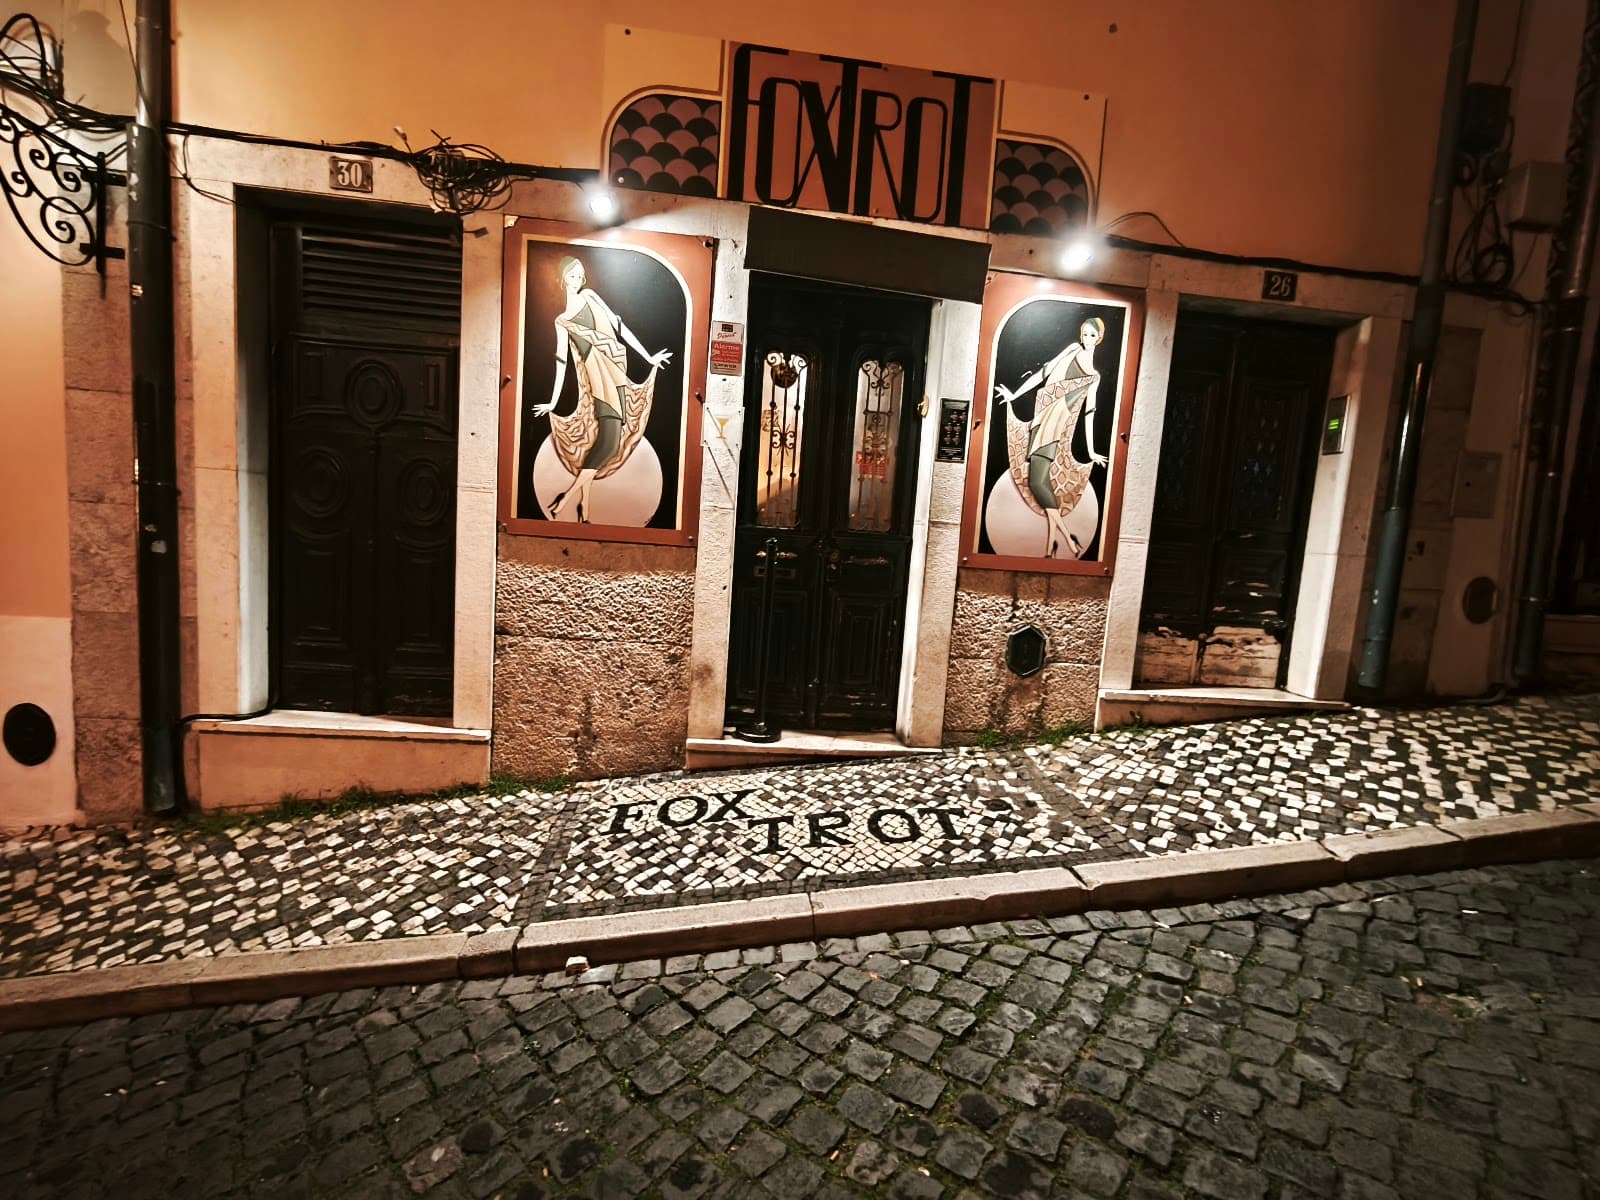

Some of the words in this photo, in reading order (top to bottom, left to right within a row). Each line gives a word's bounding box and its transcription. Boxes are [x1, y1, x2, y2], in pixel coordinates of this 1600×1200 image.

[728, 42, 994, 227] FOXTROT
[337, 161, 363, 187] 30
[1269, 275, 1291, 297] 26
[601, 789, 756, 835] FOX
[748, 807, 966, 855] TROT
